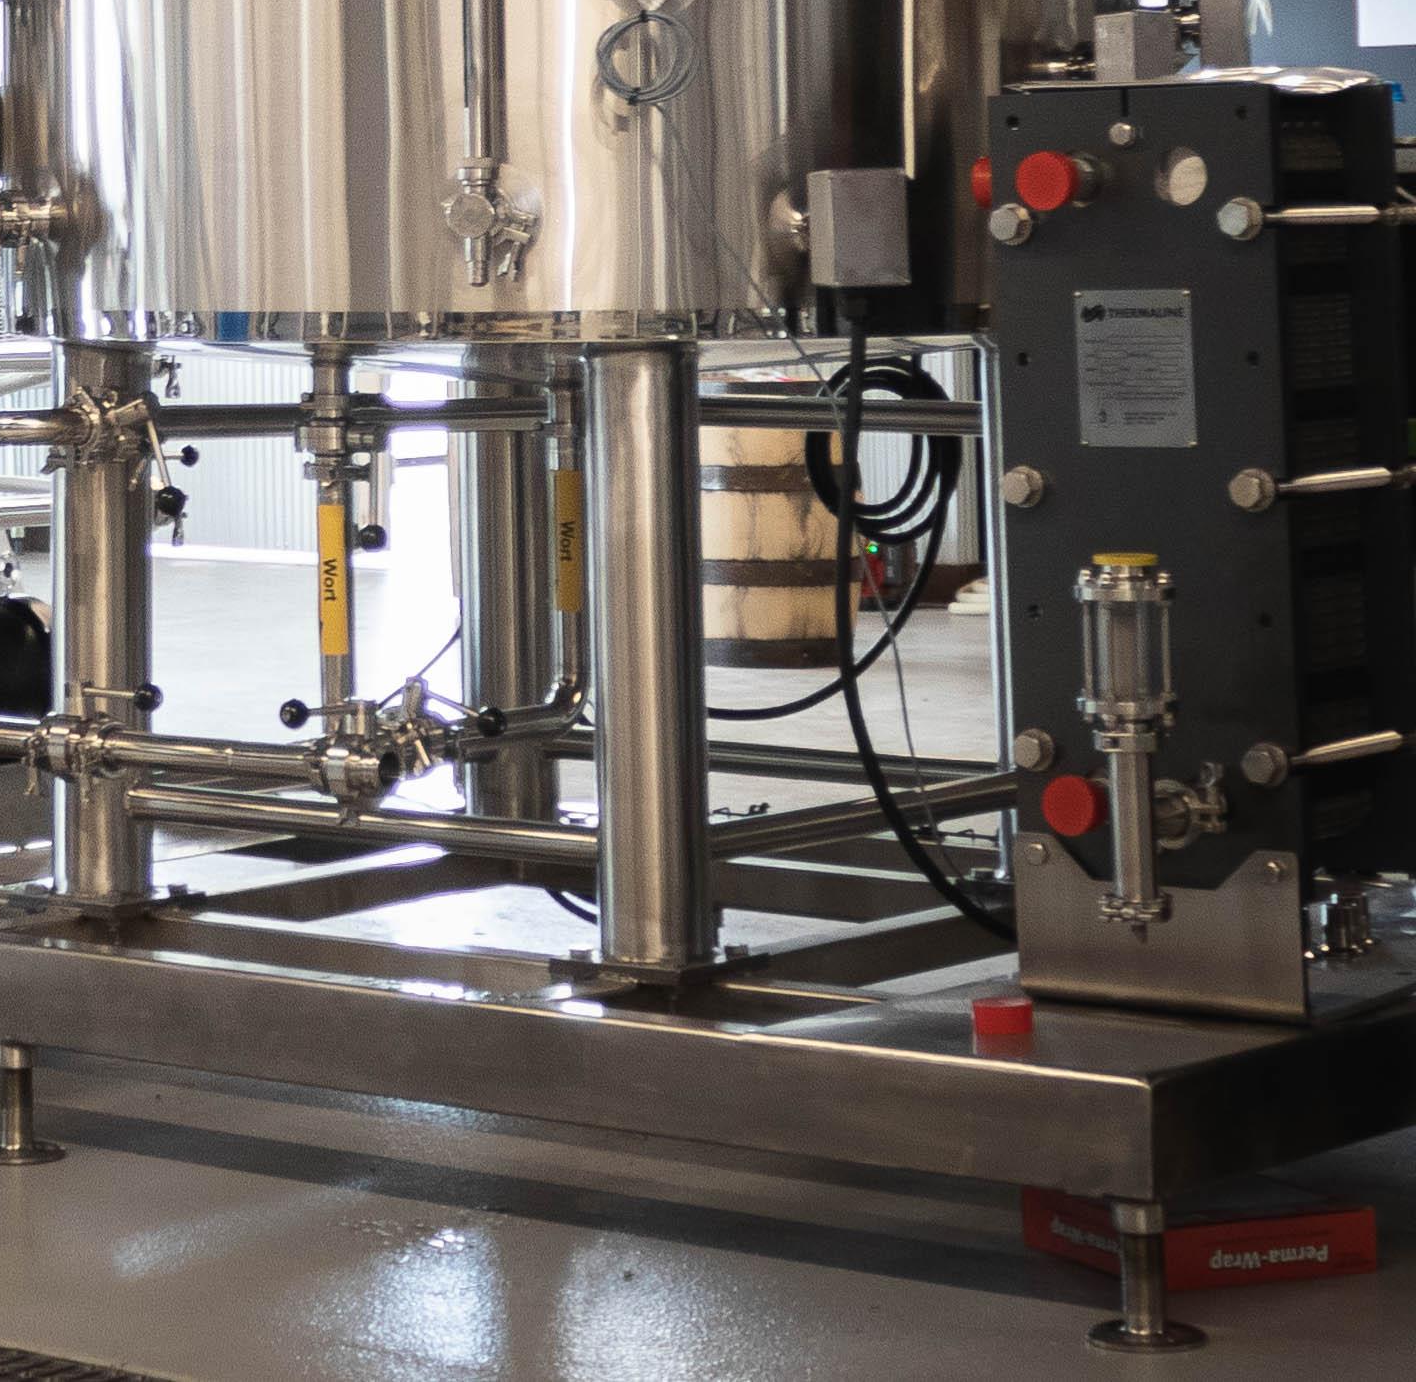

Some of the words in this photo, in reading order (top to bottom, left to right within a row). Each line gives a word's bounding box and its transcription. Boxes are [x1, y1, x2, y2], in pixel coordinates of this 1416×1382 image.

[560, 521, 575, 562] Wort
[323, 558, 338, 602] Wort
[1209, 1244, 1329, 1269] Perma-Wrap
